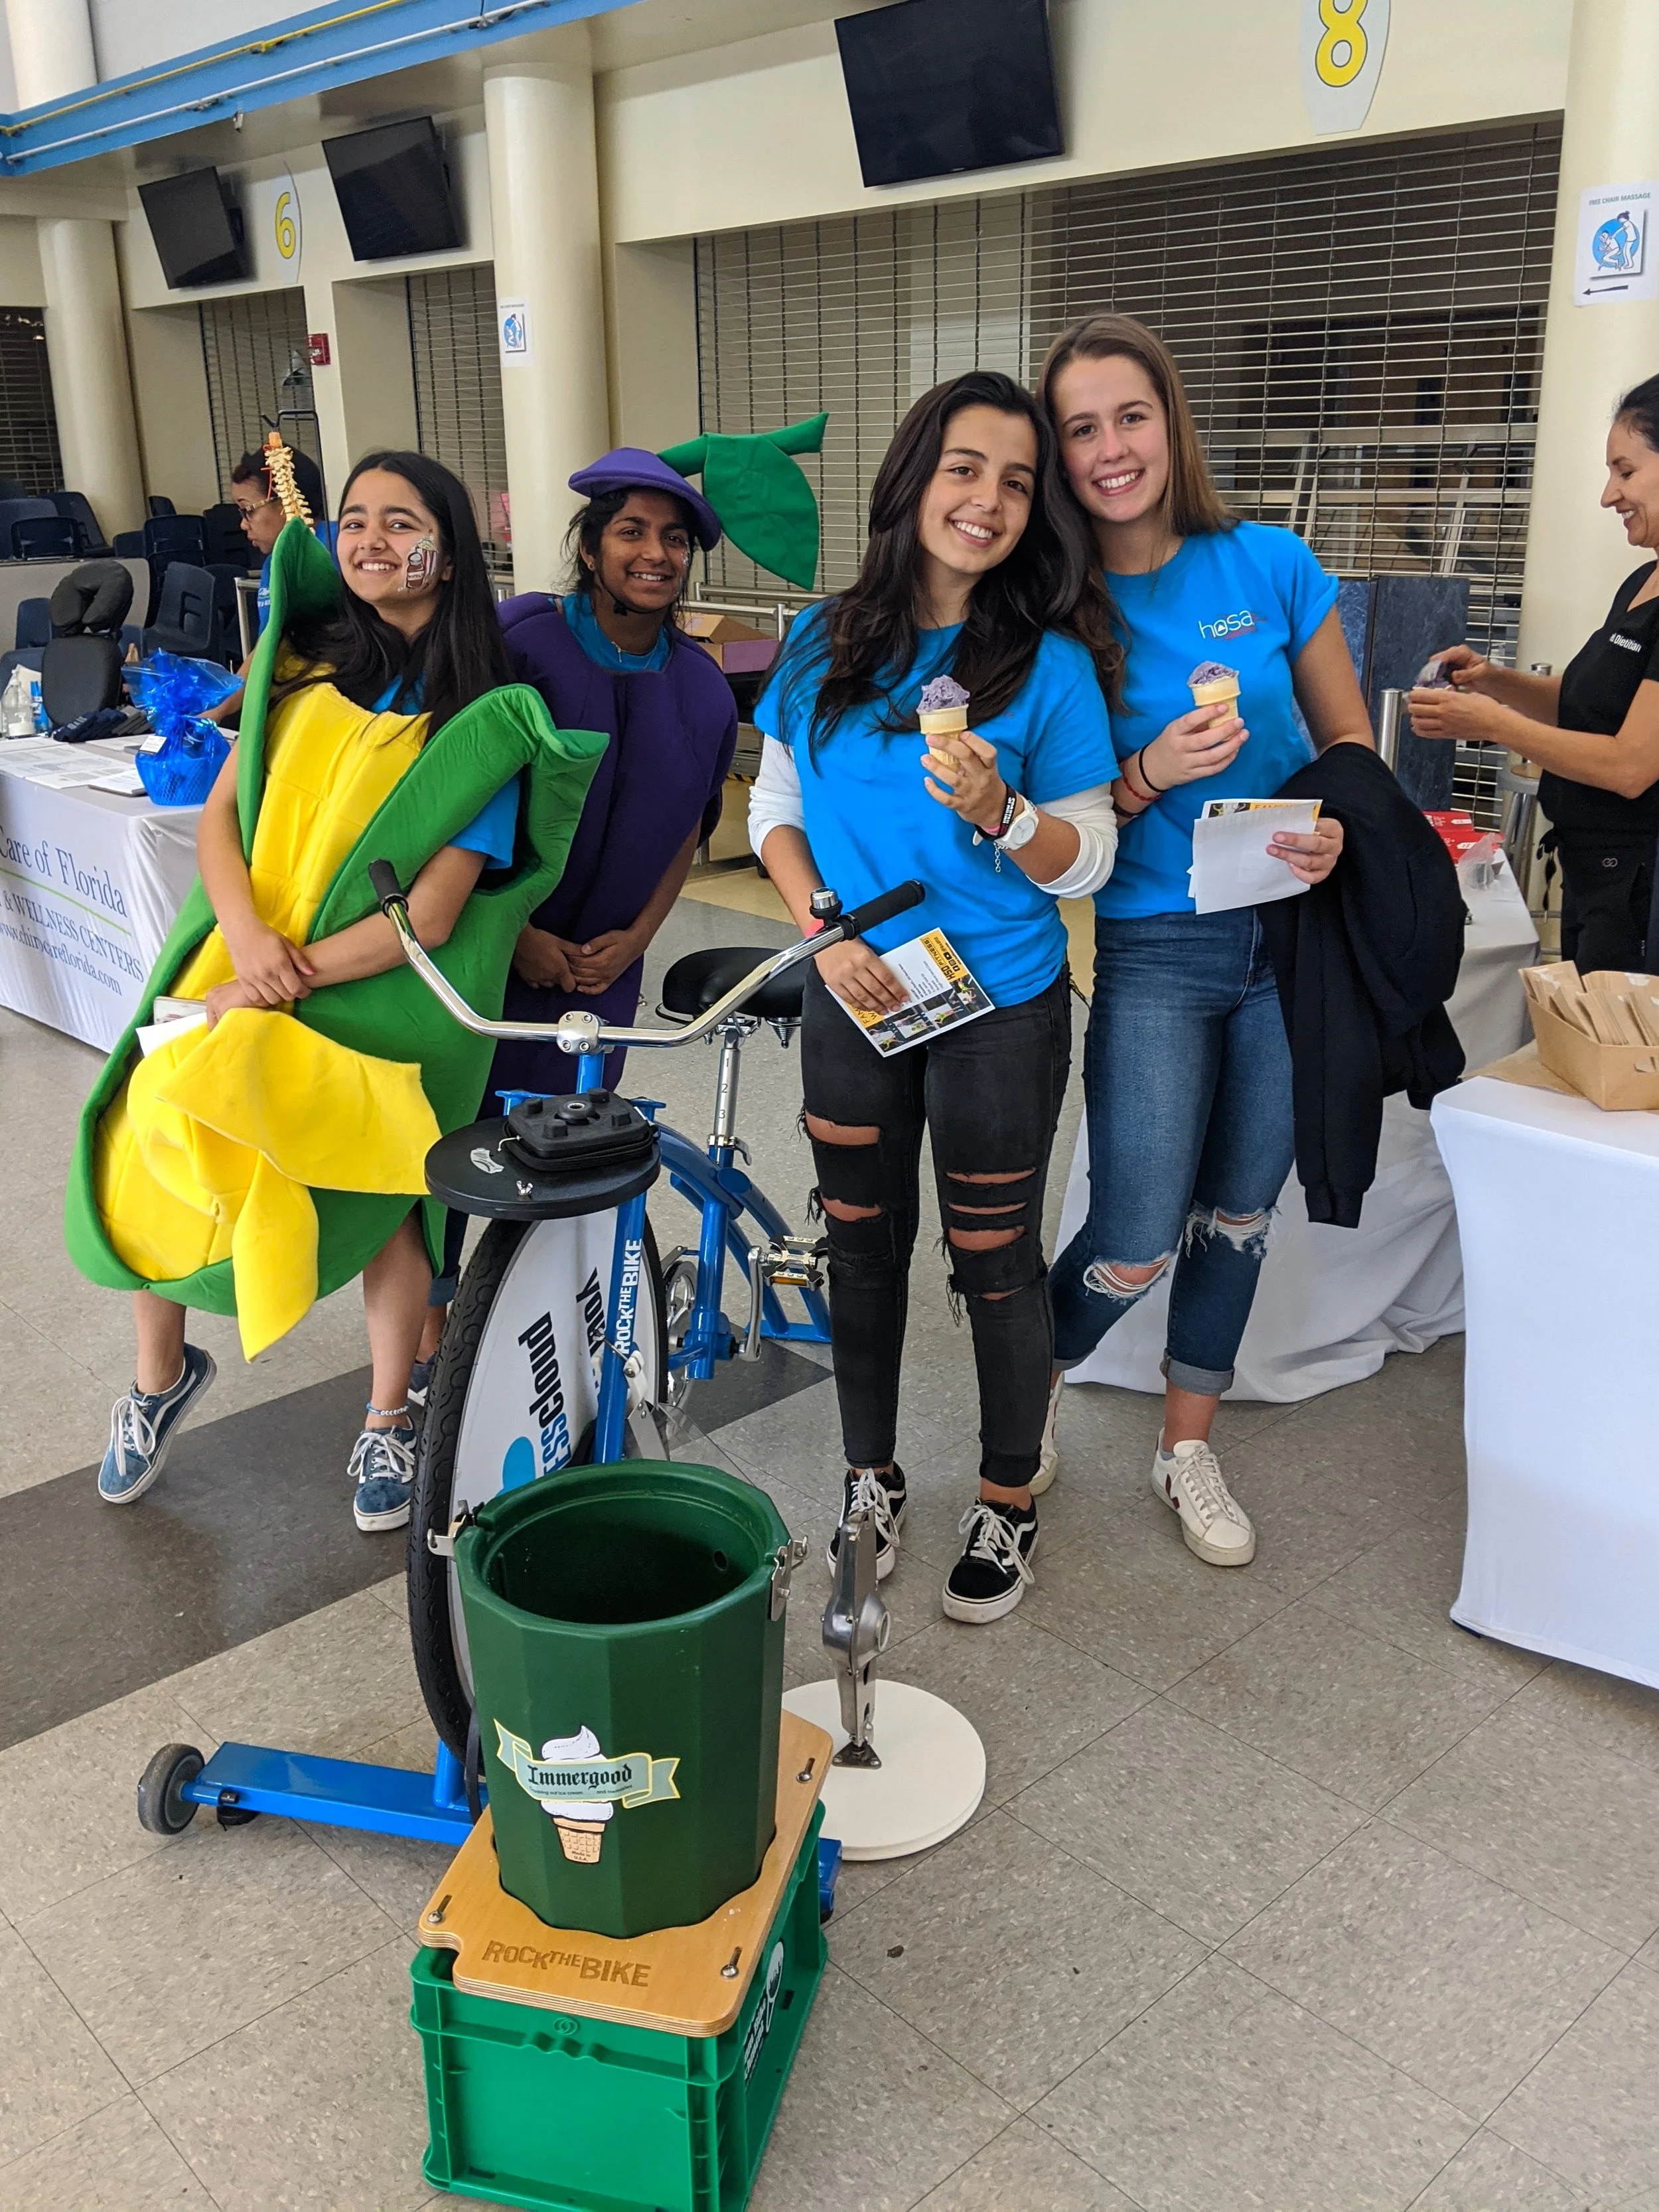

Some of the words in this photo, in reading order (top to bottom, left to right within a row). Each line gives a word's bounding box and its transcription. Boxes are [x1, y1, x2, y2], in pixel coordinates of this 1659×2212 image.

[1315, 0, 1368, 88] 8
[1621, 192, 1651, 201] MASSAGE
[275, 191, 296, 259] 6
[1198, 610, 1255, 639] hosa
[1614, 635, 1642, 652] Dietitian
[35, 840, 53, 877] of
[55, 848, 128, 918] Florida
[3, 890, 13, 911] &
[12, 893, 79, 942] WELLNESS
[80, 925, 144, 983] CENTERS
[924, 939, 944, 966] FITNESS
[726, 1057, 729, 1067] 1
[721, 1083, 728, 1093] 2
[719, 1109, 726, 1119] 3
[528, 1763, 632, 1790] Immergood
